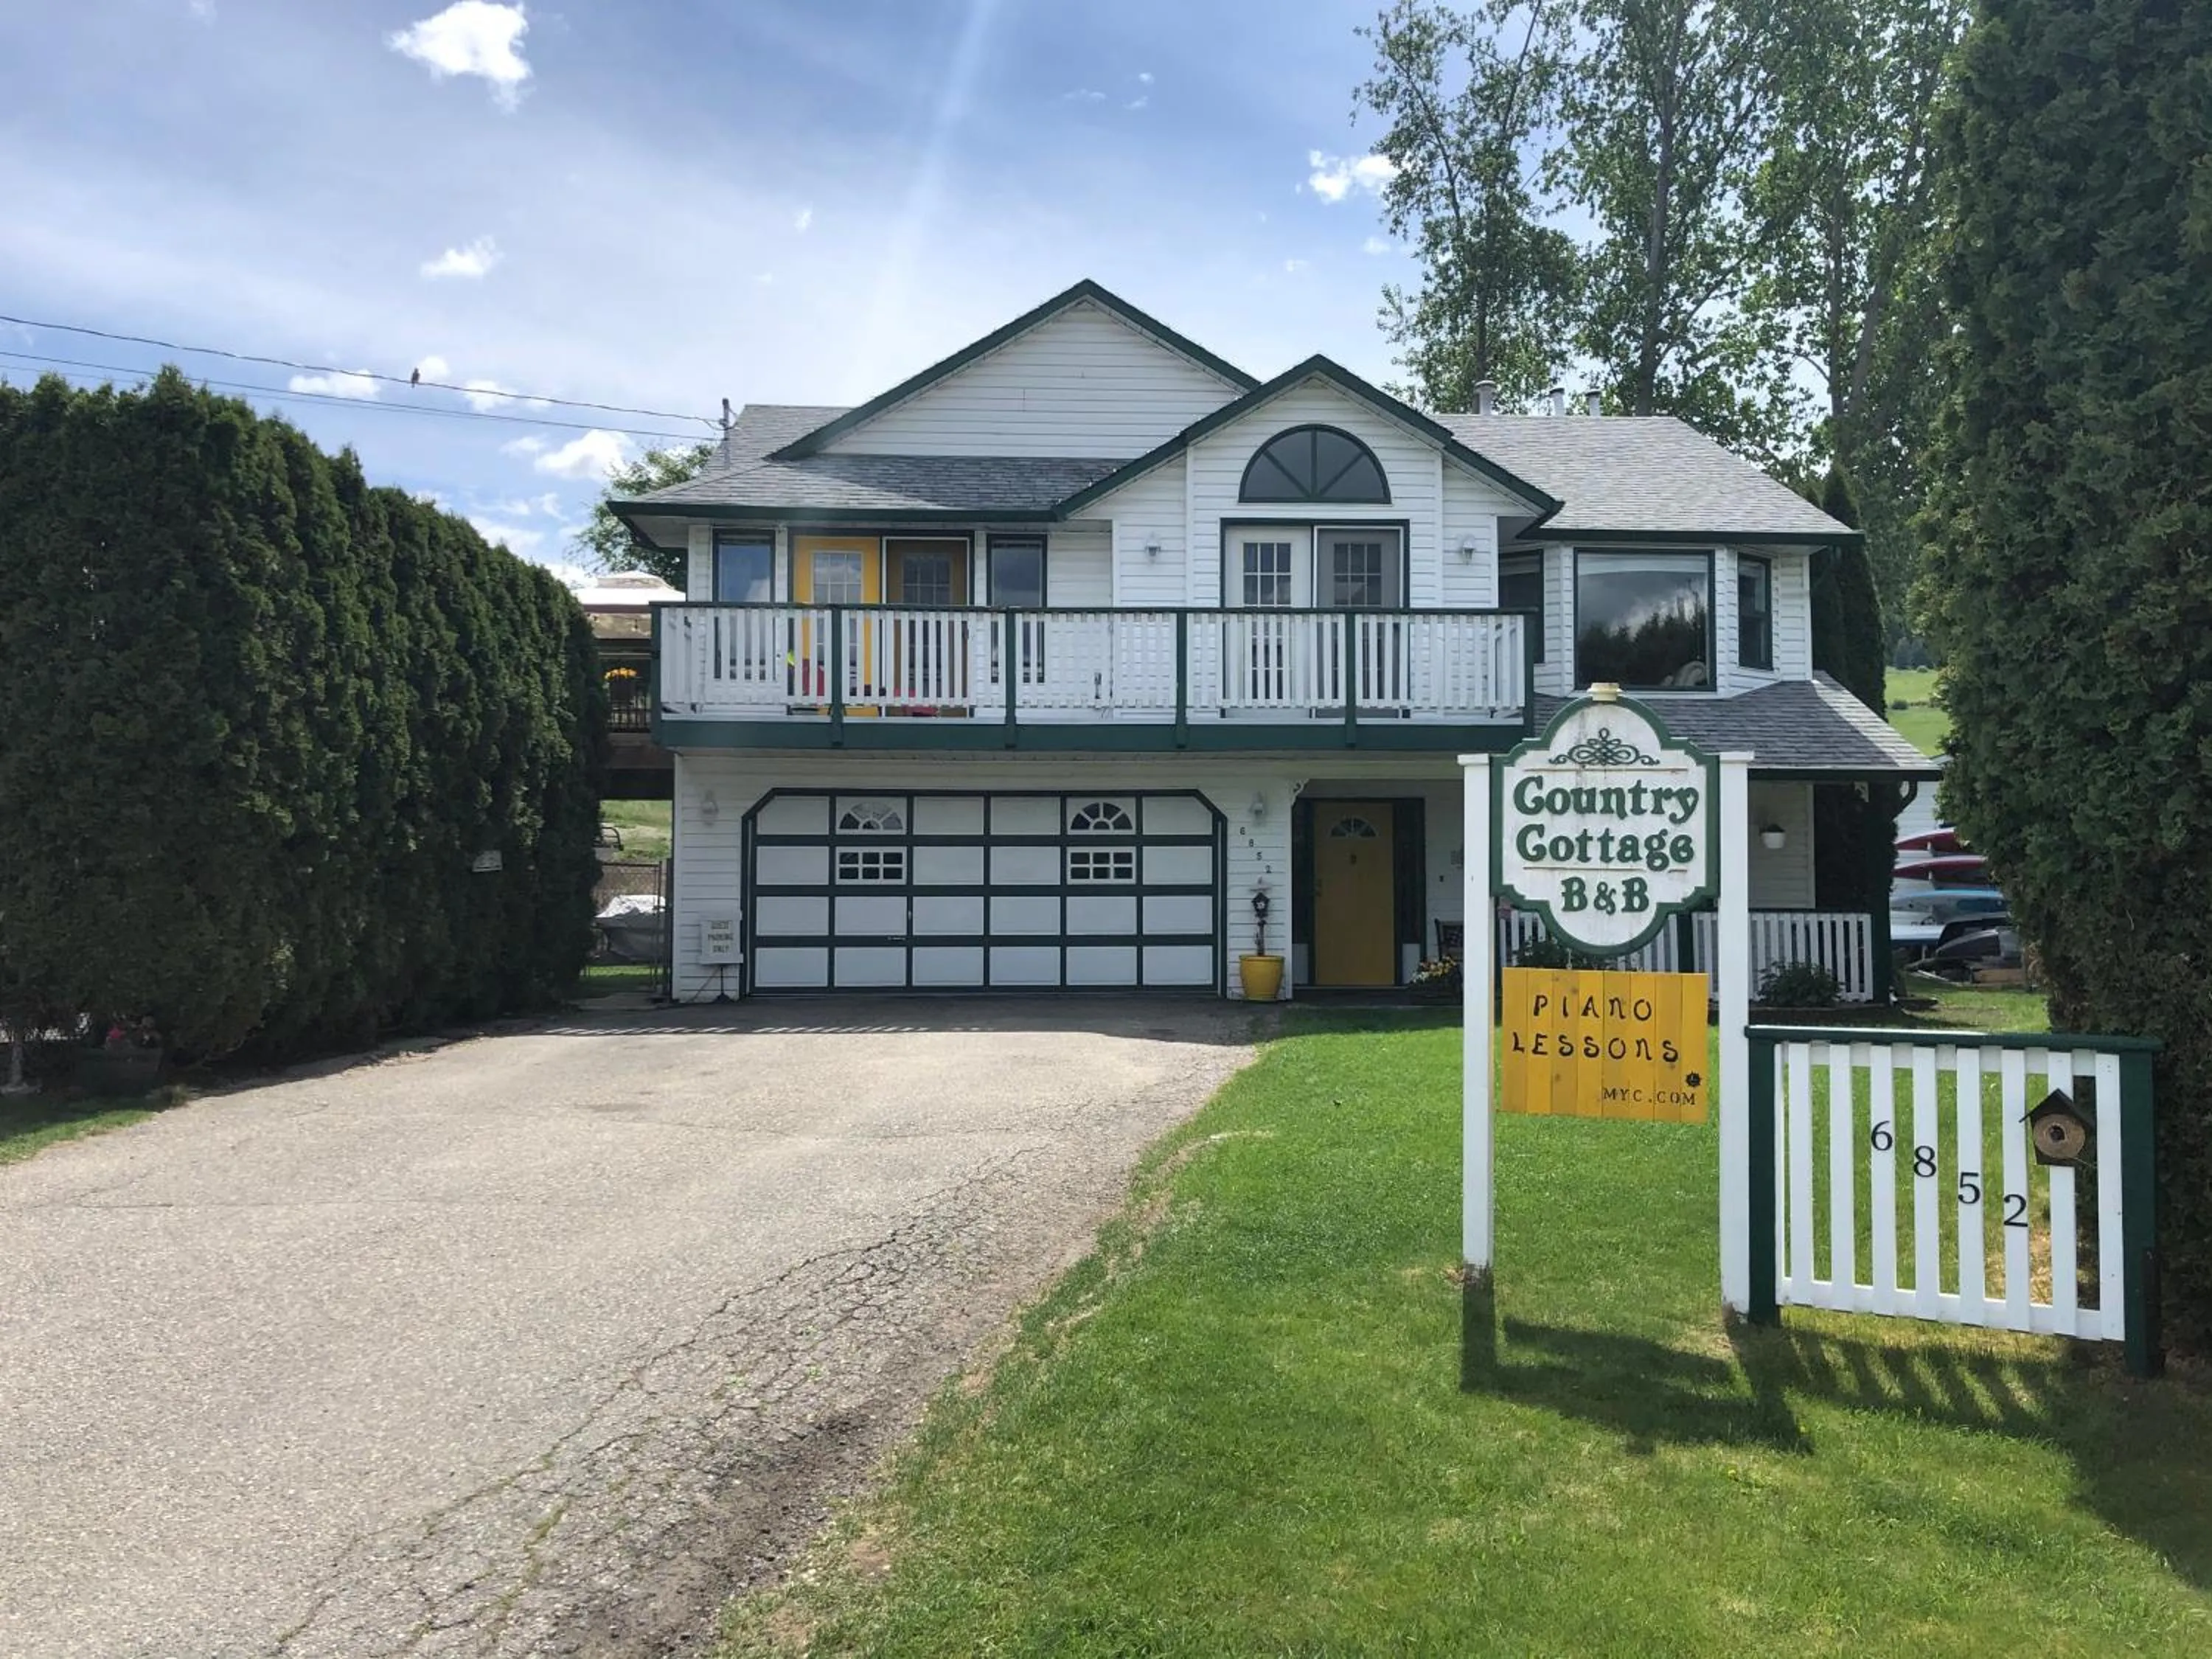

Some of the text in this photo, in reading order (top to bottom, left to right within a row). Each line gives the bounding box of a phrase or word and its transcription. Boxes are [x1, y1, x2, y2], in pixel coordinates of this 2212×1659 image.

[1513, 775, 1699, 824] Country
[1516, 824, 1694, 872] Cottage
[1560, 877, 1649, 915] B&B
[1604, 1088, 1696, 1105] MYC.COM
[1871, 1120, 2028, 1228] 6852
